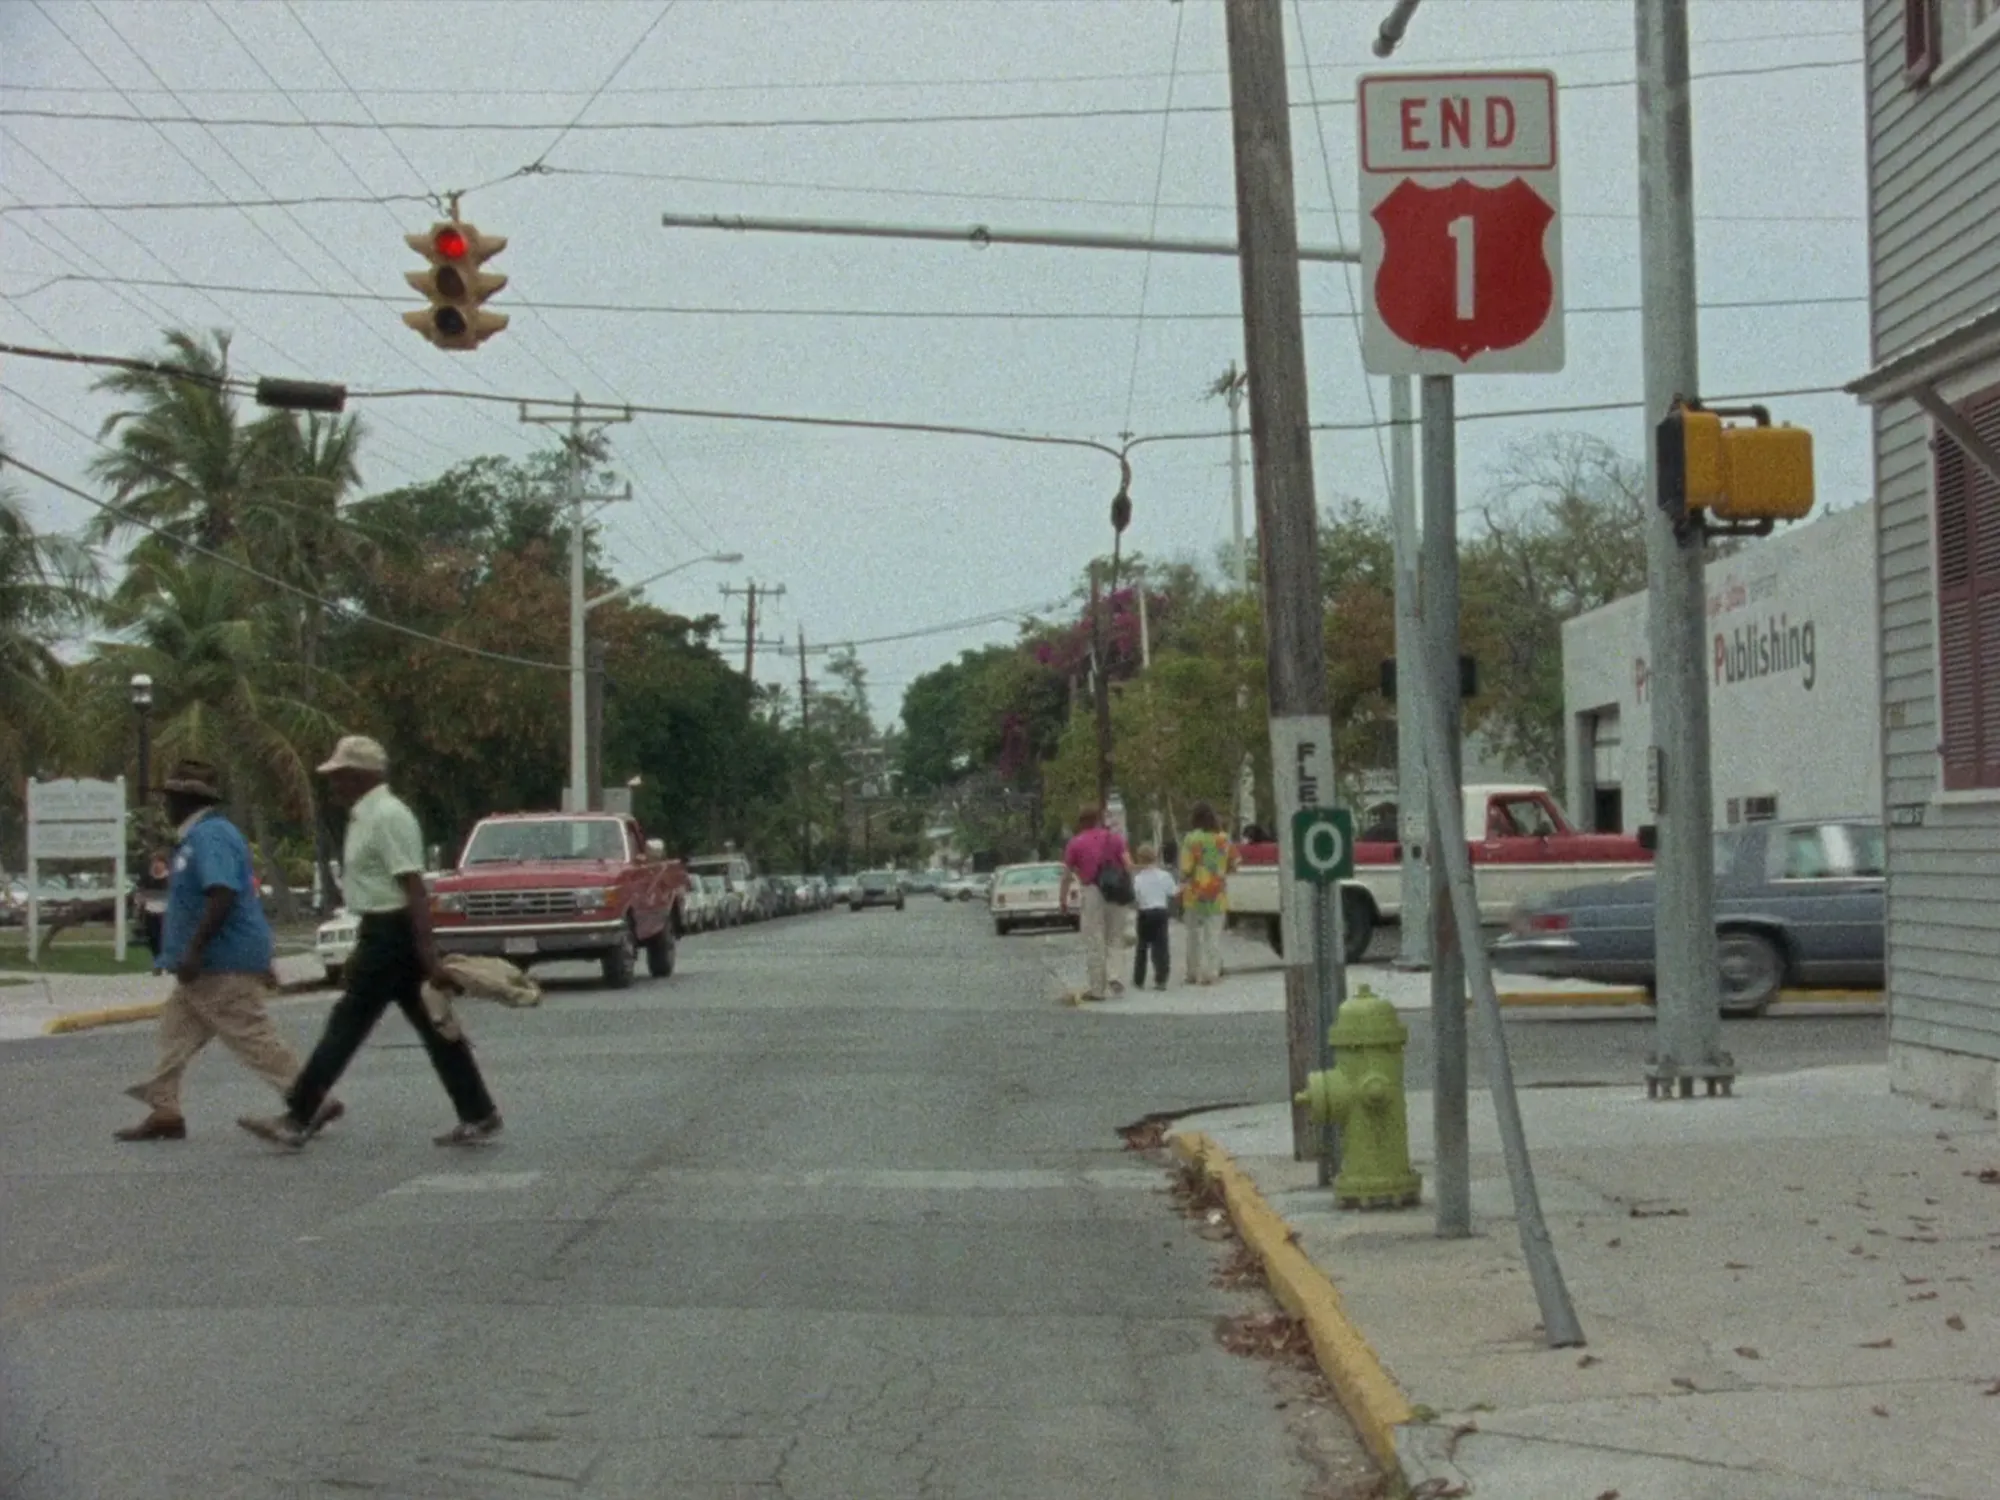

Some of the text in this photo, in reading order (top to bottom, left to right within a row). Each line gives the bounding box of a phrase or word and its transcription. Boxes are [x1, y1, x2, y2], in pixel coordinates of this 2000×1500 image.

[1400, 96, 1516, 151] END
[1448, 215, 1475, 321] 1
[1713, 612, 1816, 691] Publishing
